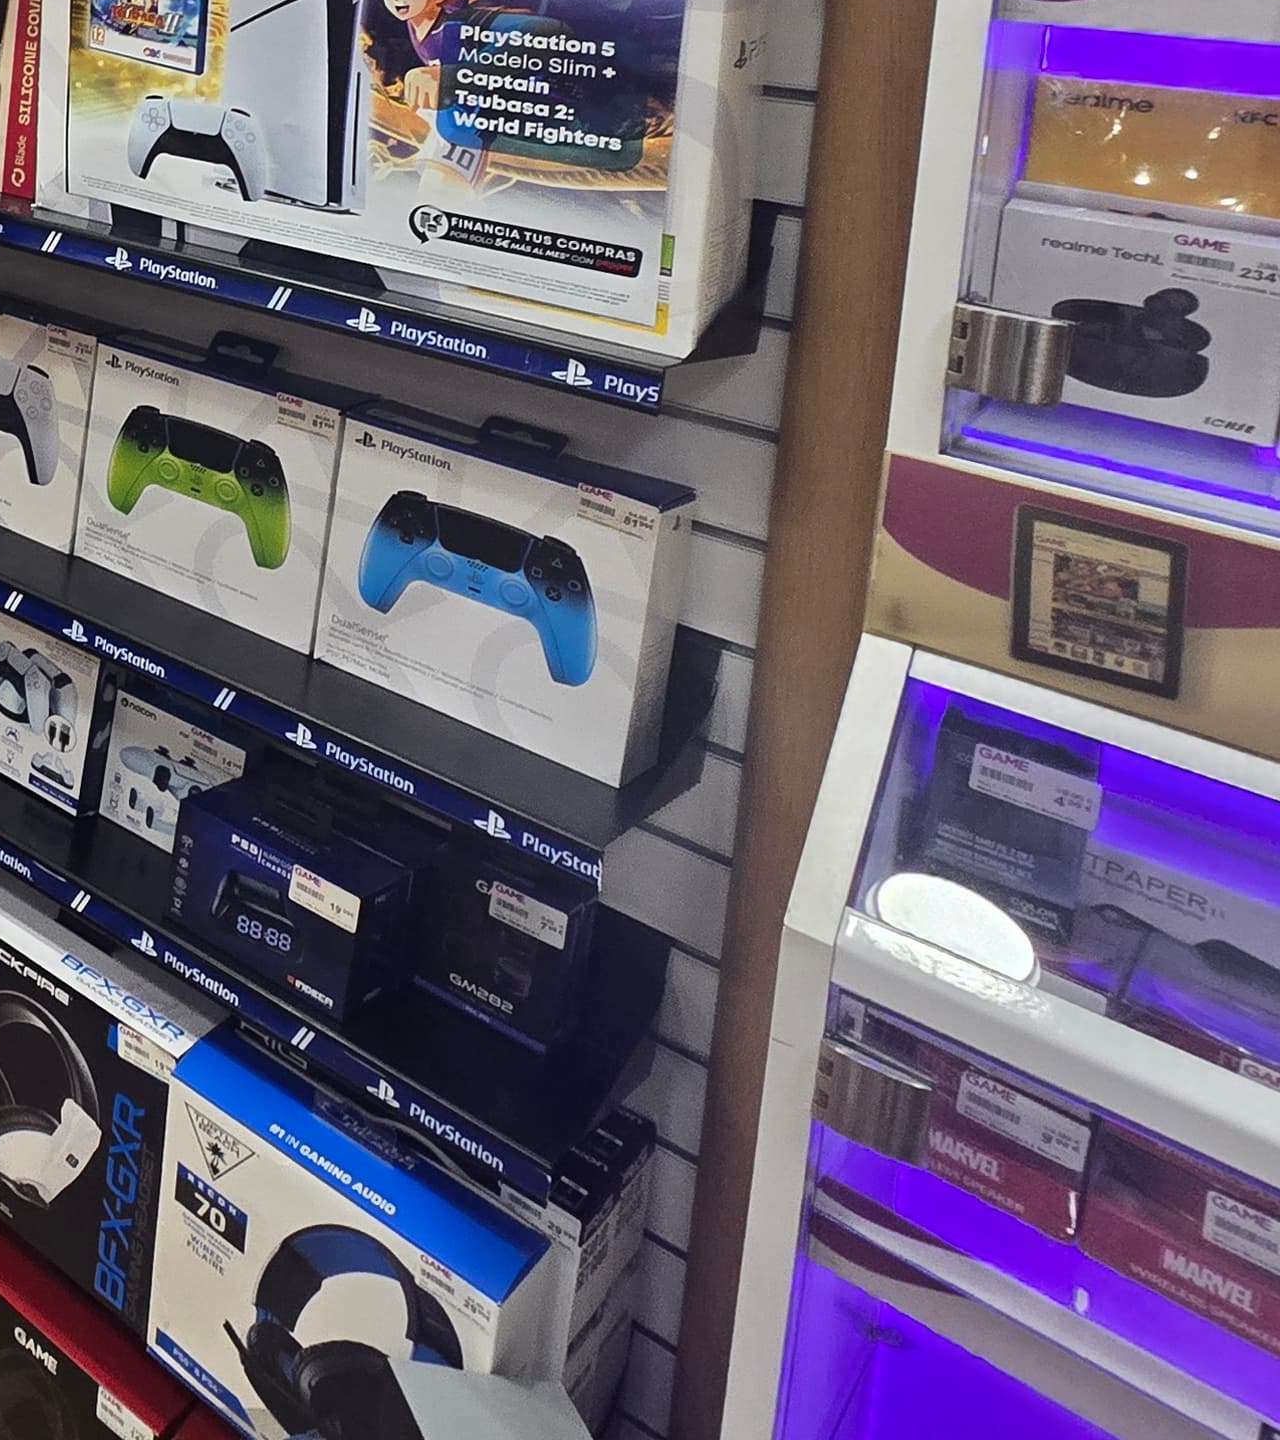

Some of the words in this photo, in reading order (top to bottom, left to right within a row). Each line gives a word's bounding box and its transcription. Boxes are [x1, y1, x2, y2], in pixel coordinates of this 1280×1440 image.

[459, 24, 596, 57] PlayStation
[599, 39, 617, 56] 5
[456, 68, 550, 97] Captain
[457, 47, 543, 71] Modelo
[548, 57, 597, 79] Slim
[601, 64, 617, 81] +
[18, 43, 38, 127] SILICONE
[455, 90, 541, 117] Tsubasa
[548, 100, 576, 120] 2:
[453, 110, 519, 137] World
[523, 120, 622, 152] Fighters
[14, 135, 29, 181] Blade
[450, 217, 520, 240] FINANCIA
[524, 231, 553, 246] TUS
[556, 238, 636, 262] COMPRAS
[1174, 233, 1231, 254] GAME
[137, 255, 217, 291] PlayStation
[390, 320, 488, 361] PlayStation
[331, 613, 390, 644] DualSense
[130, 698, 157, 721] nacon
[325, 741, 415, 795] PlayStation
[978, 744, 1031, 772] GAME
[164, 951, 240, 1007] PlayStation
[449, 973, 514, 1013] GM282
[965, 1071, 1018, 1105] GAME
[409, 1102, 504, 1172] PlayStation
[269, 1123, 286, 1139] #1
[285, 1133, 299, 1149] IN
[299, 1144, 352, 1185] GAMING
[351, 1182, 396, 1216] AUDIO
[94, 1092, 145, 1310] BFX-GXR
[194, 1192, 226, 1233] 70
[1211, 1194, 1273, 1229] GAME
[186, 1241, 224, 1276] FILAIRE
[190, 1234, 224, 1264] WIRED
[1163, 1248, 1257, 1314] MARVEL
[14, 1326, 59, 1375] GAME
